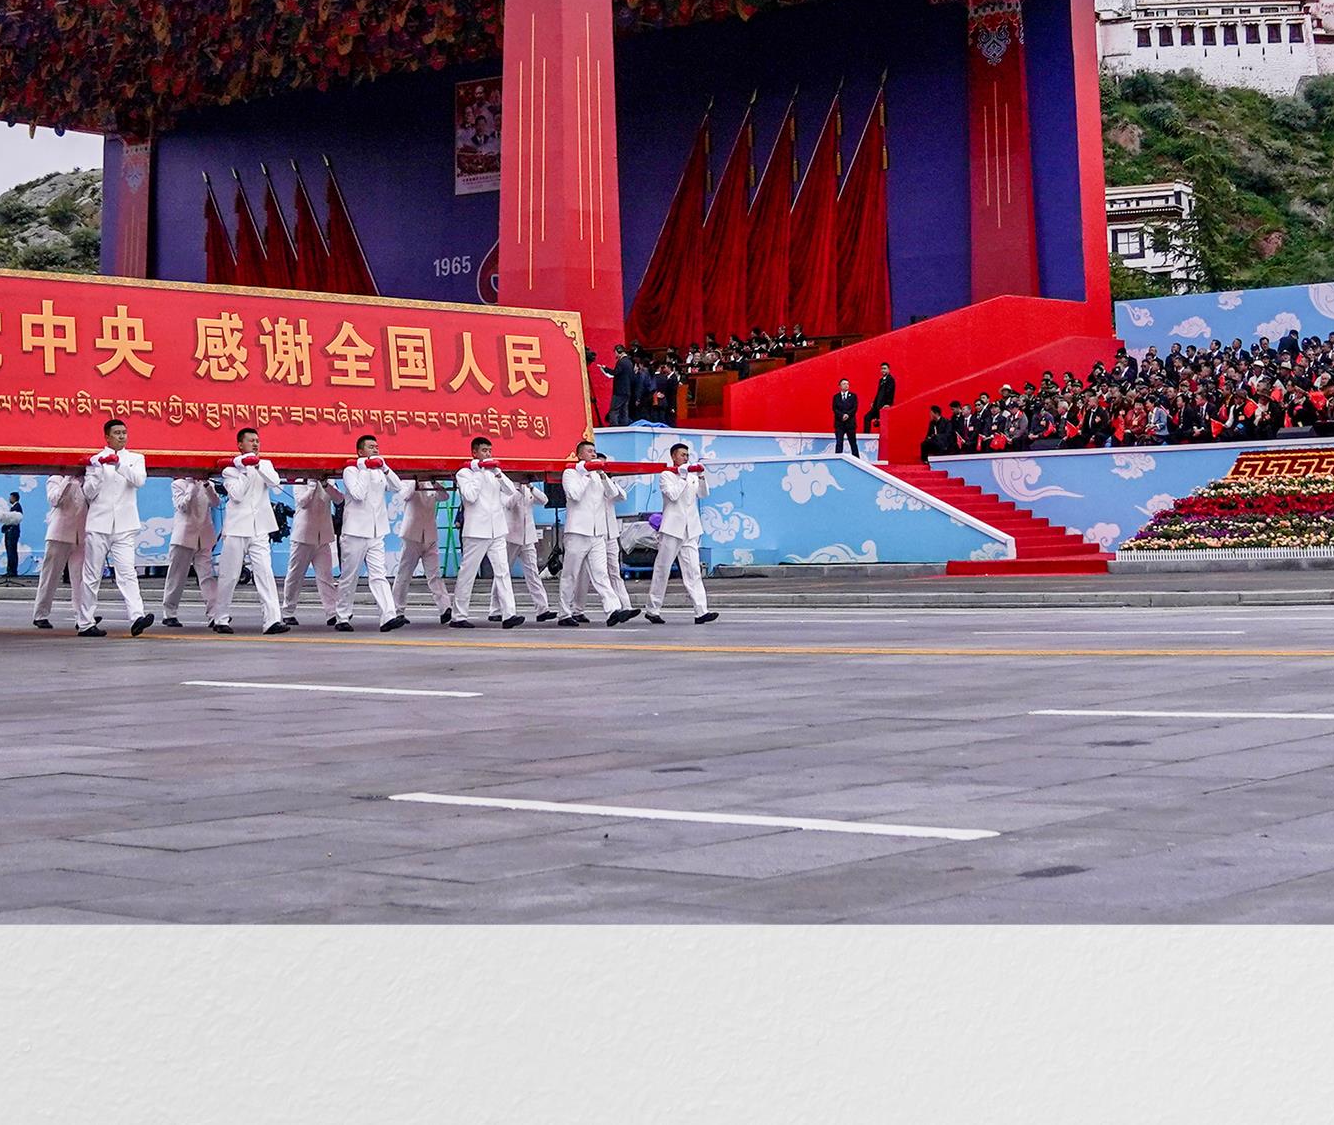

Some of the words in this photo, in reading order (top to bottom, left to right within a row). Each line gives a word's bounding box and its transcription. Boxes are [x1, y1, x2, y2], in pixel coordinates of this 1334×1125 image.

[433, 255, 472, 277] 1965
[195, 311, 551, 397] 感谢全国人民
